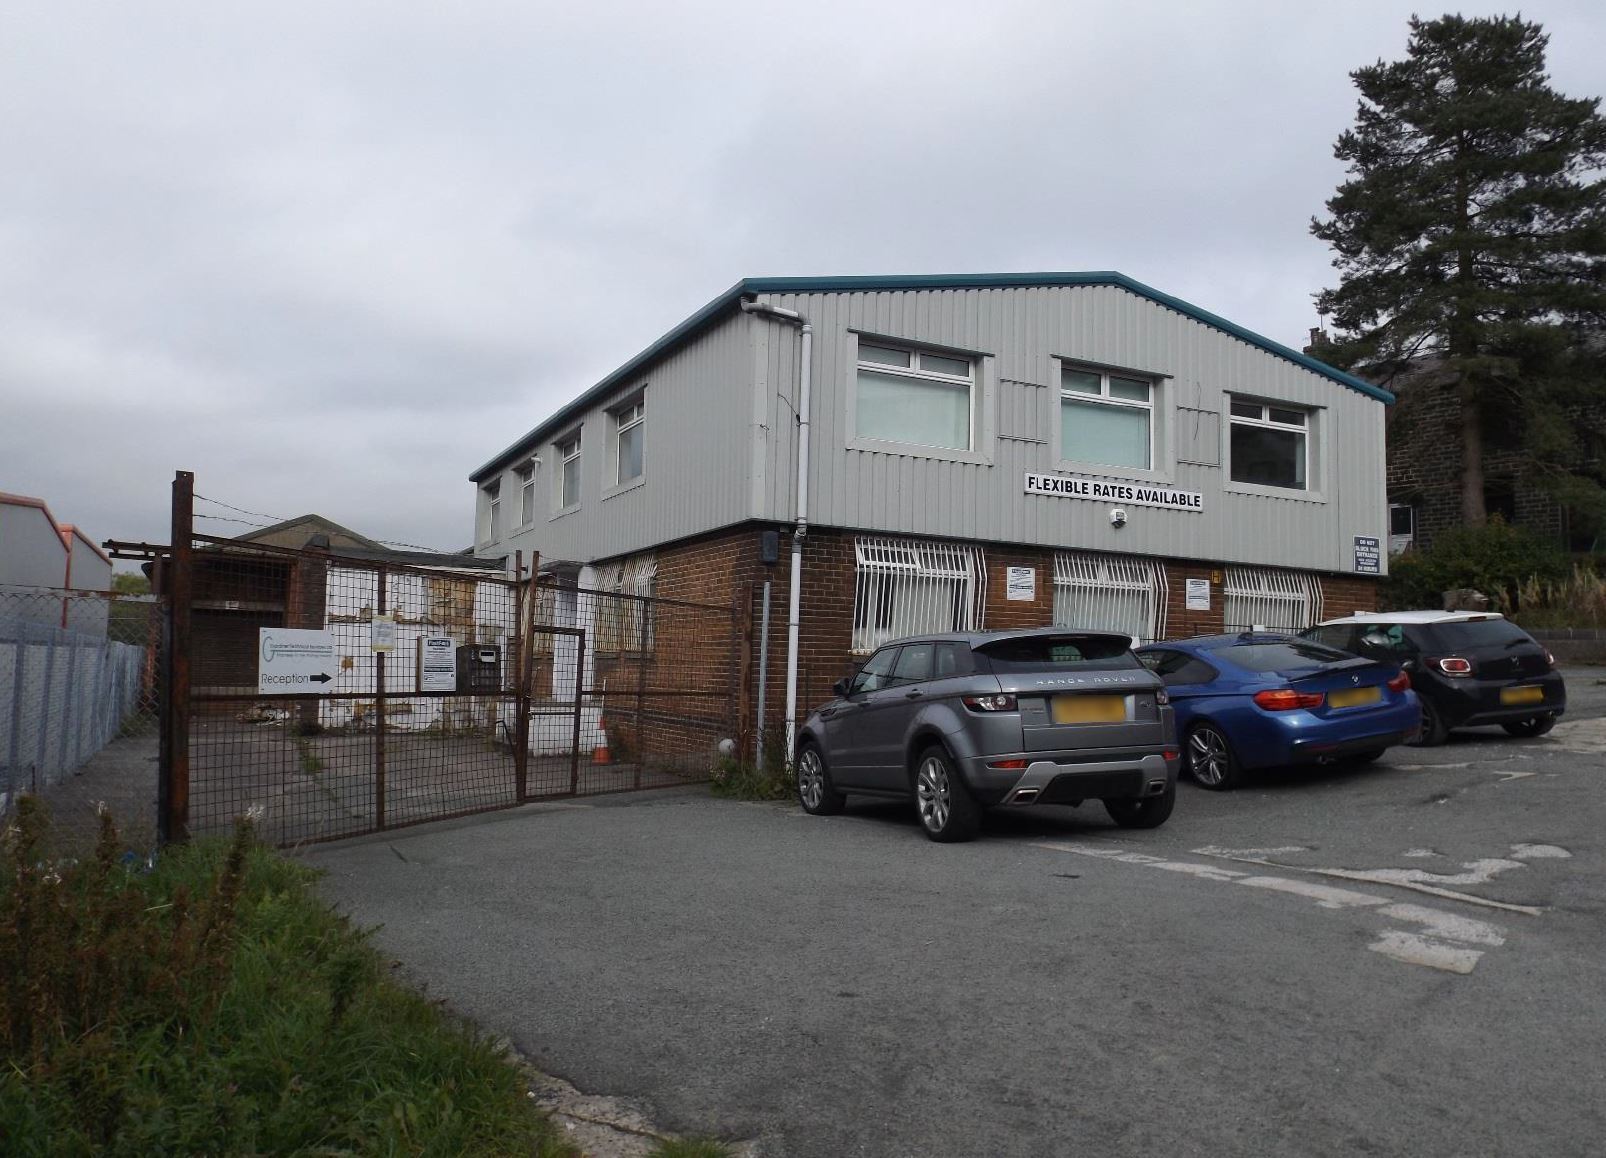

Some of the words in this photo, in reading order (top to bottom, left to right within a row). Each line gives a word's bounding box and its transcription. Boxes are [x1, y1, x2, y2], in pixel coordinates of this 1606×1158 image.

[1028, 476, 1089, 495] FLEXIBLE
[1093, 484, 1133, 499] RATES
[1136, 489, 1201, 507] AVAILABLE
[262, 673, 309, 685] Reception
